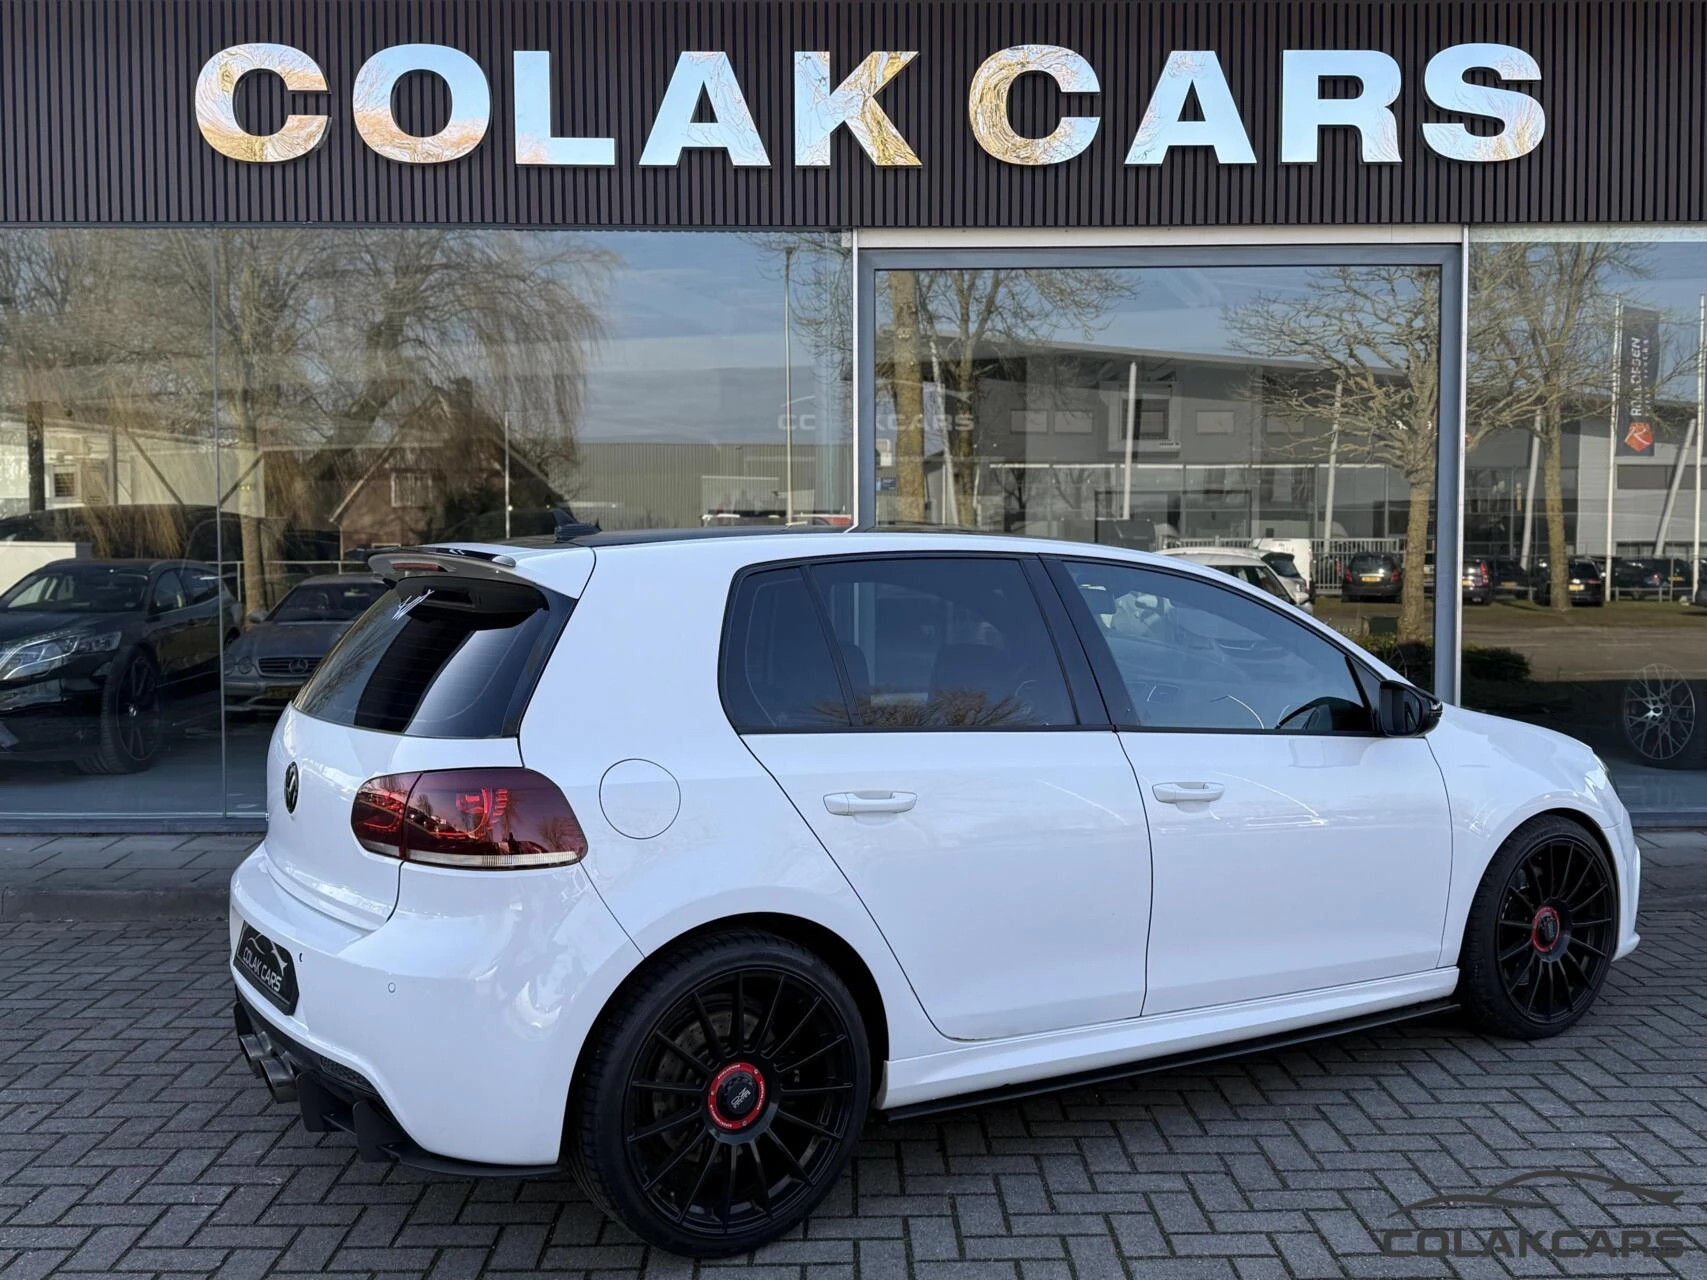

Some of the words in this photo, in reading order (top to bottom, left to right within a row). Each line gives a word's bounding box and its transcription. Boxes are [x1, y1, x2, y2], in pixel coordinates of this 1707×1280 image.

[194, 43, 922, 167] COLAK
[968, 43, 1546, 166] CARS
[243, 947, 262, 975] COLAK
[261, 964, 282, 992] CARS
